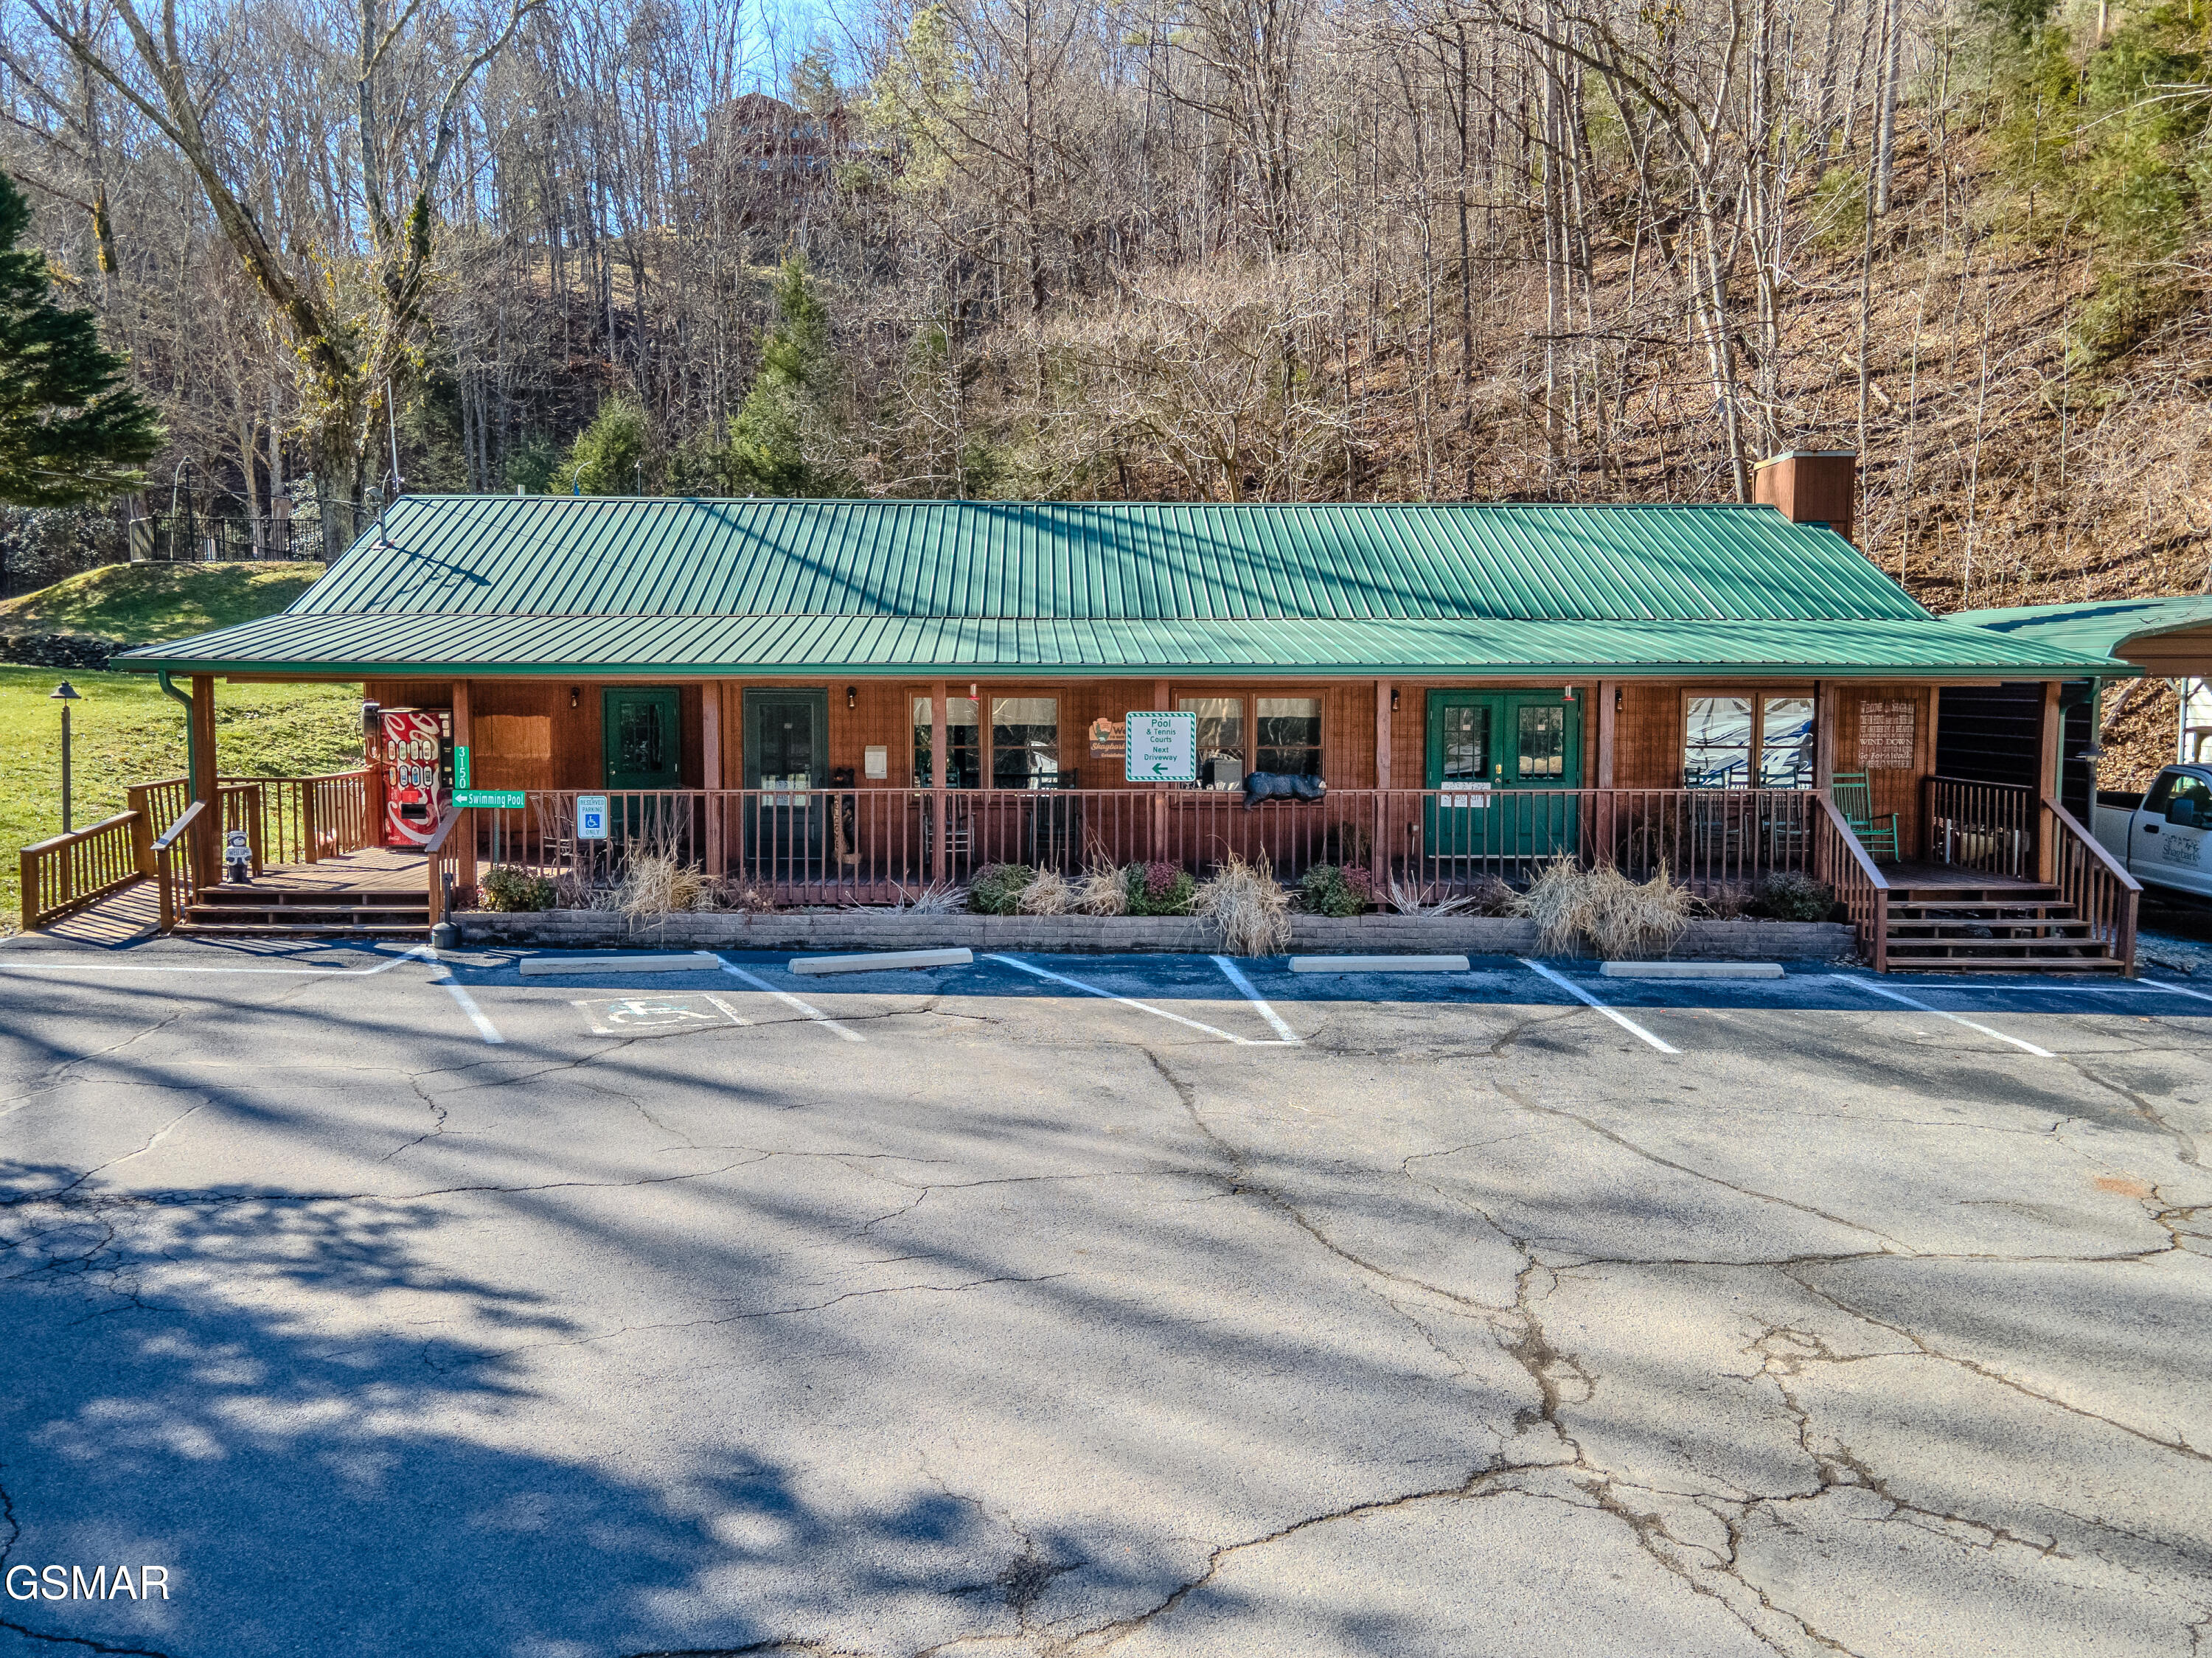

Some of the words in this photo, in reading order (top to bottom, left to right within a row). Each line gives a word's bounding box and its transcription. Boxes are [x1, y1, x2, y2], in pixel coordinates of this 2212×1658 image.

[1151, 719, 1171, 728] Pool
[1144, 753, 1178, 762] Driveway
[469, 793, 506, 808] Swimming
[507, 793, 524, 805] Pool
